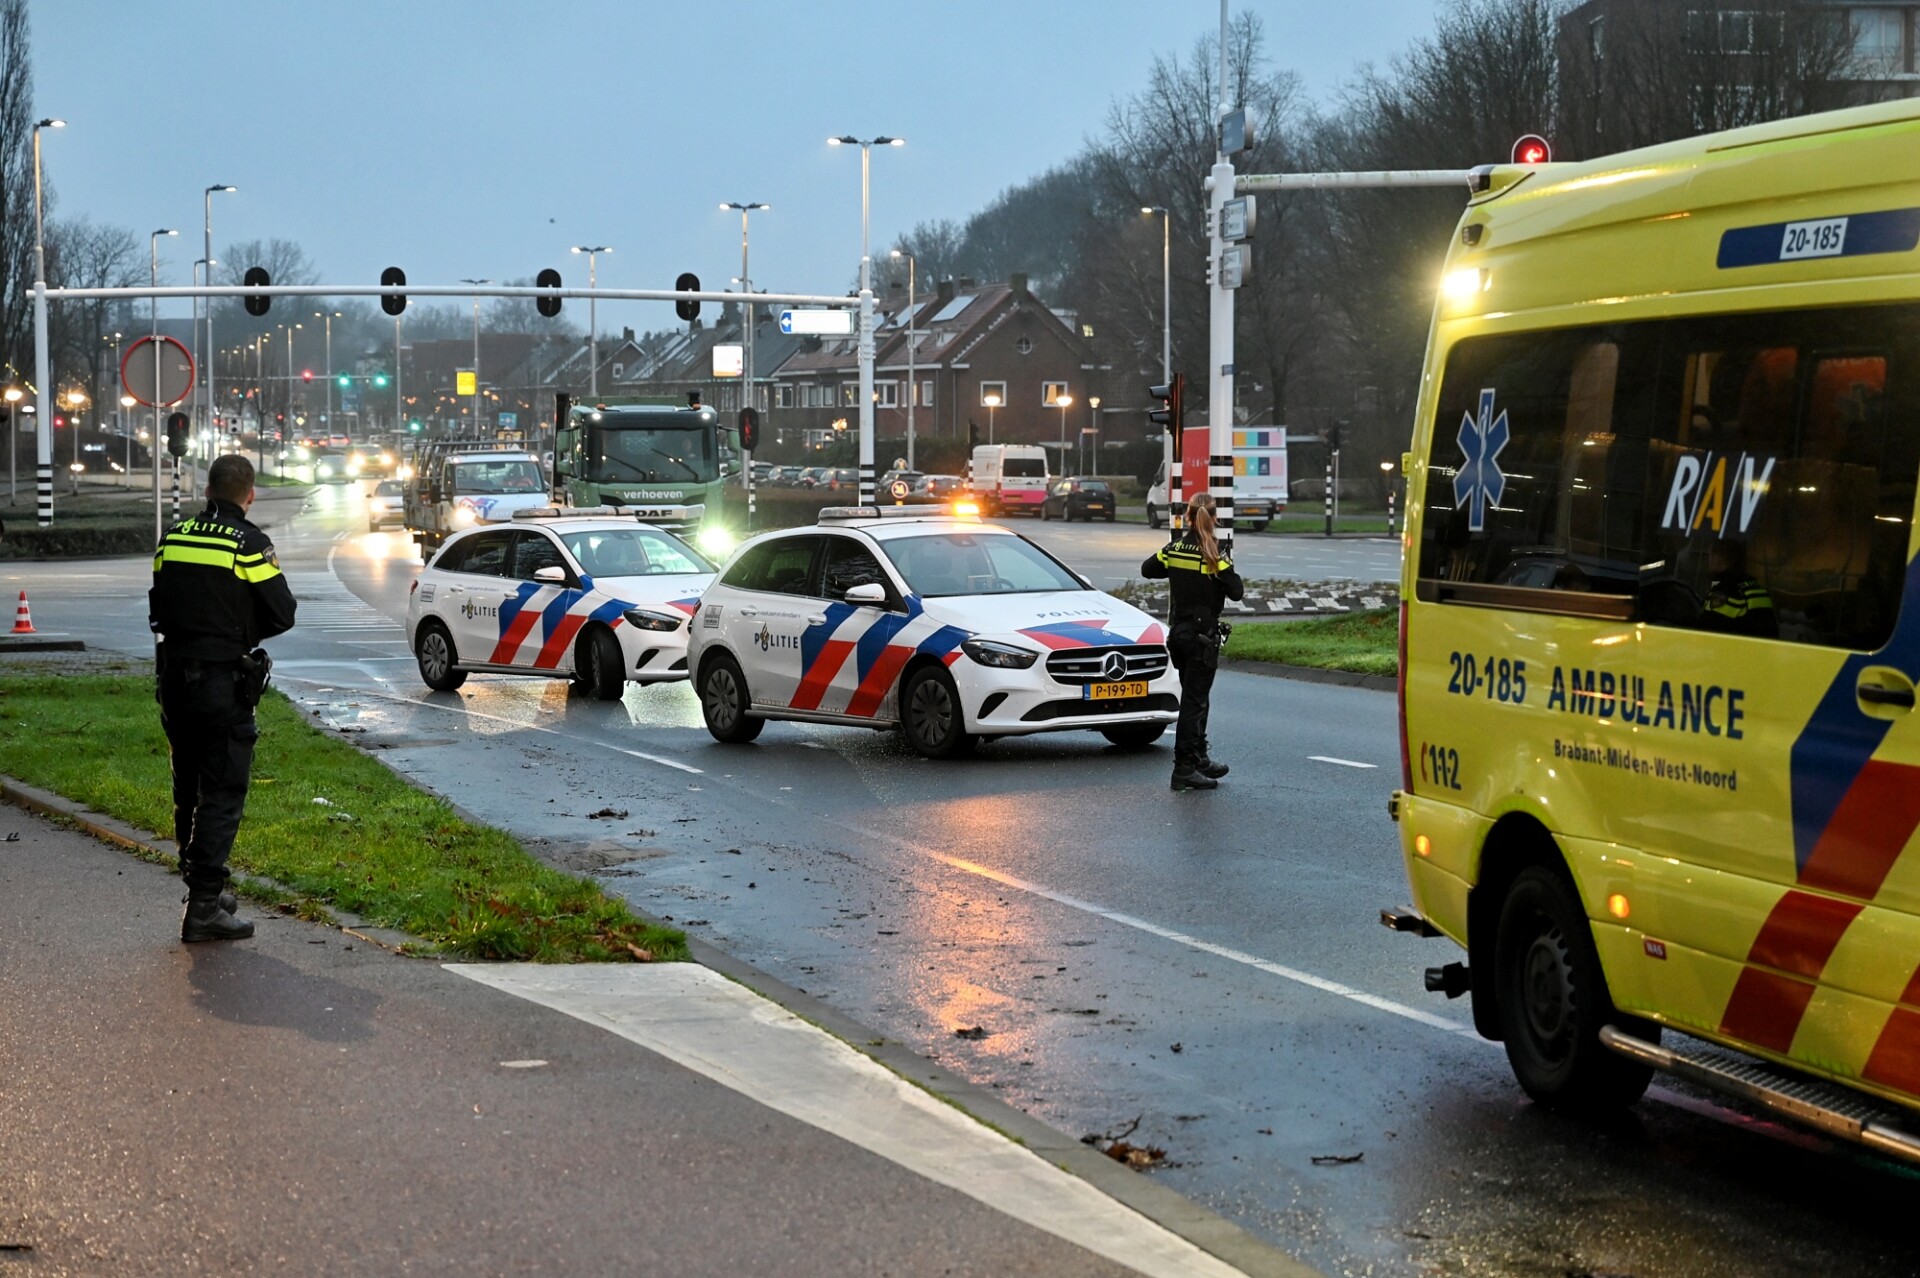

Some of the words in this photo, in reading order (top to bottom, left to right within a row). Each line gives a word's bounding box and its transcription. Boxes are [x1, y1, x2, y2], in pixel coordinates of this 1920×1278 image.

[1785, 224, 1842, 254] 20-185
[623, 489, 683, 499] verhoeven
[634, 509, 673, 517] DAF
[461, 600, 497, 619] POLITIE
[1036, 609, 1112, 619] POLITIE
[754, 626, 799, 651] POLITIE
[1096, 683, 1142, 697] P-199-TD
[1448, 651, 1526, 704] 20-185
[1547, 666, 1745, 740] AMBULANCE
